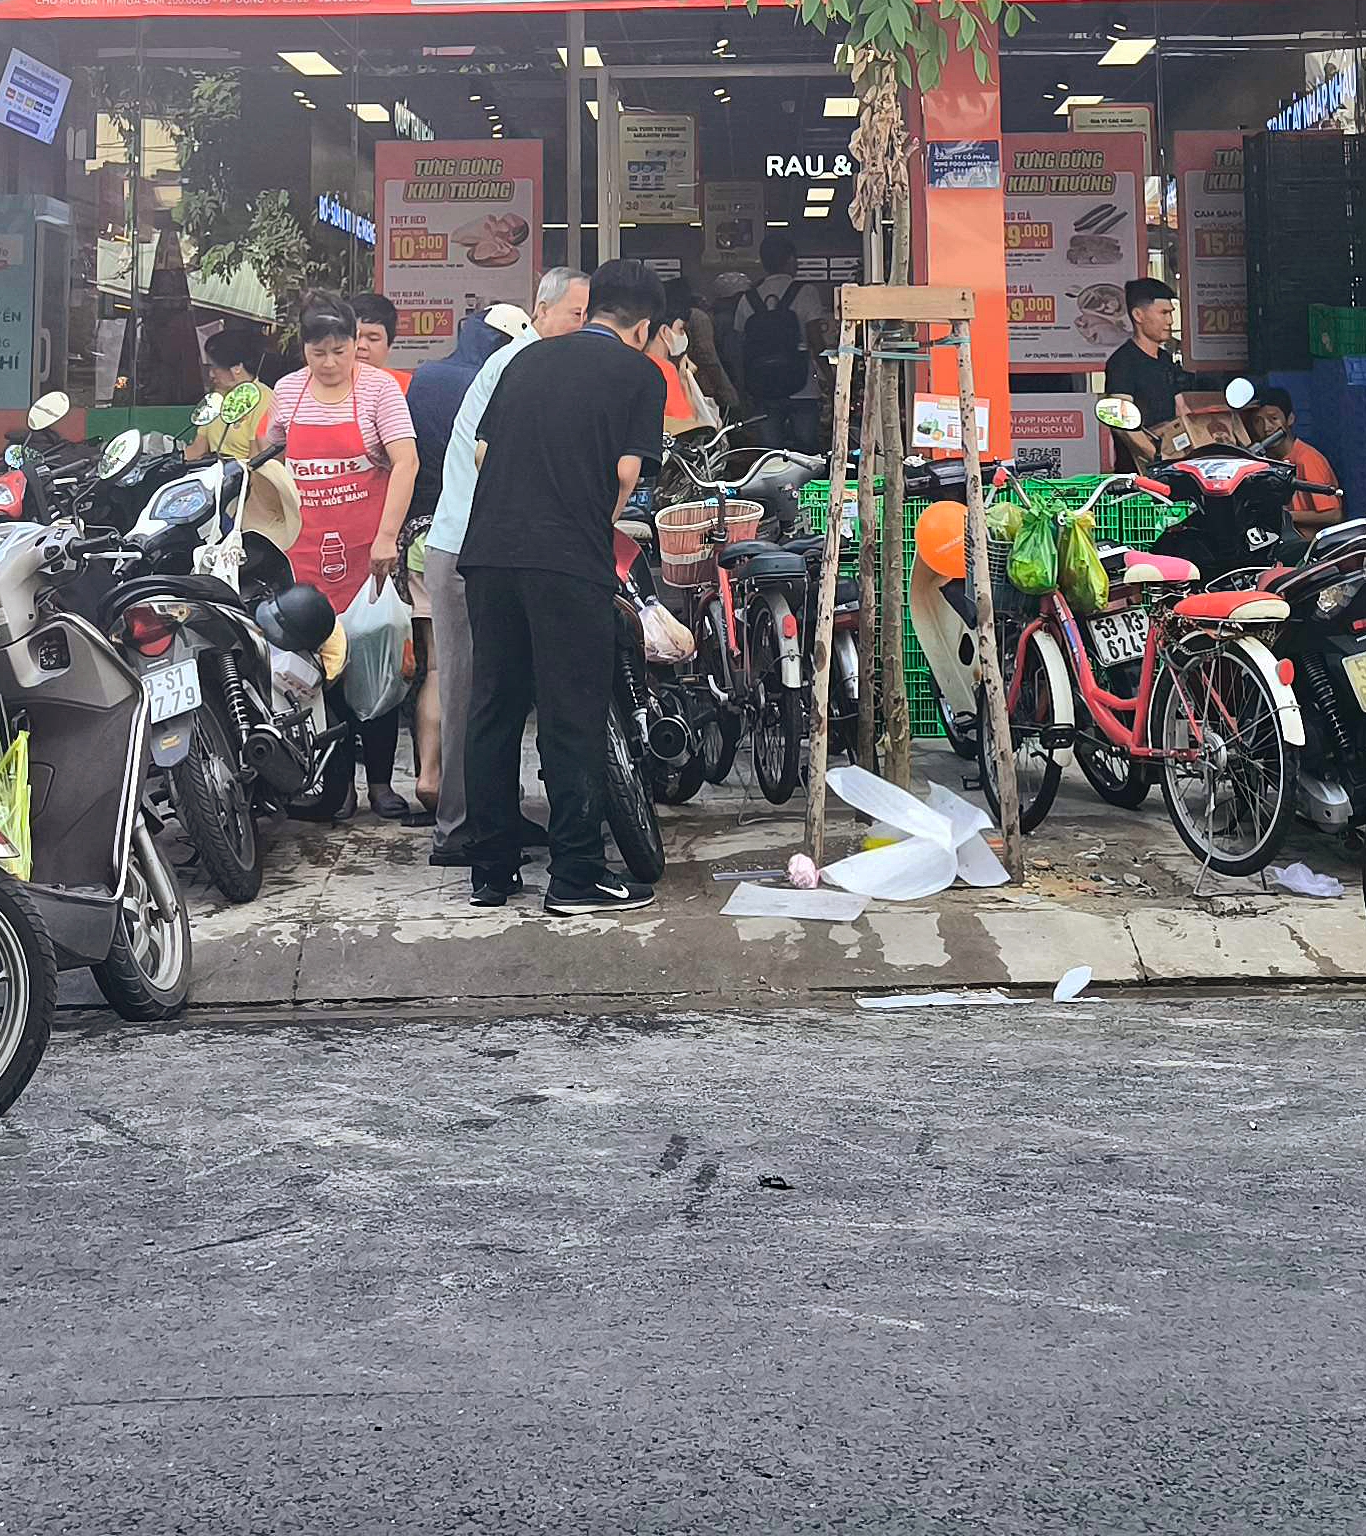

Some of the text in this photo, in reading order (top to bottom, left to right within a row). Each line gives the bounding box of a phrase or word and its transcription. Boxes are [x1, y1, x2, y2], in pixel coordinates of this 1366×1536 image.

[766, 155, 853, 178] RAU &
[406, 182, 444, 200] KHAI
[1007, 175, 1046, 193] KHAI
[392, 235, 443, 260] 10.900
[412, 311, 448, 335] 10%
[1019, 416, 1035, 424] APP
[1038, 416, 1060, 424] NGAY
[290, 460, 361, 476] Yakult
[328, 483, 358, 497] YAKULT
[144, 668, 184, 697] 9-S1
